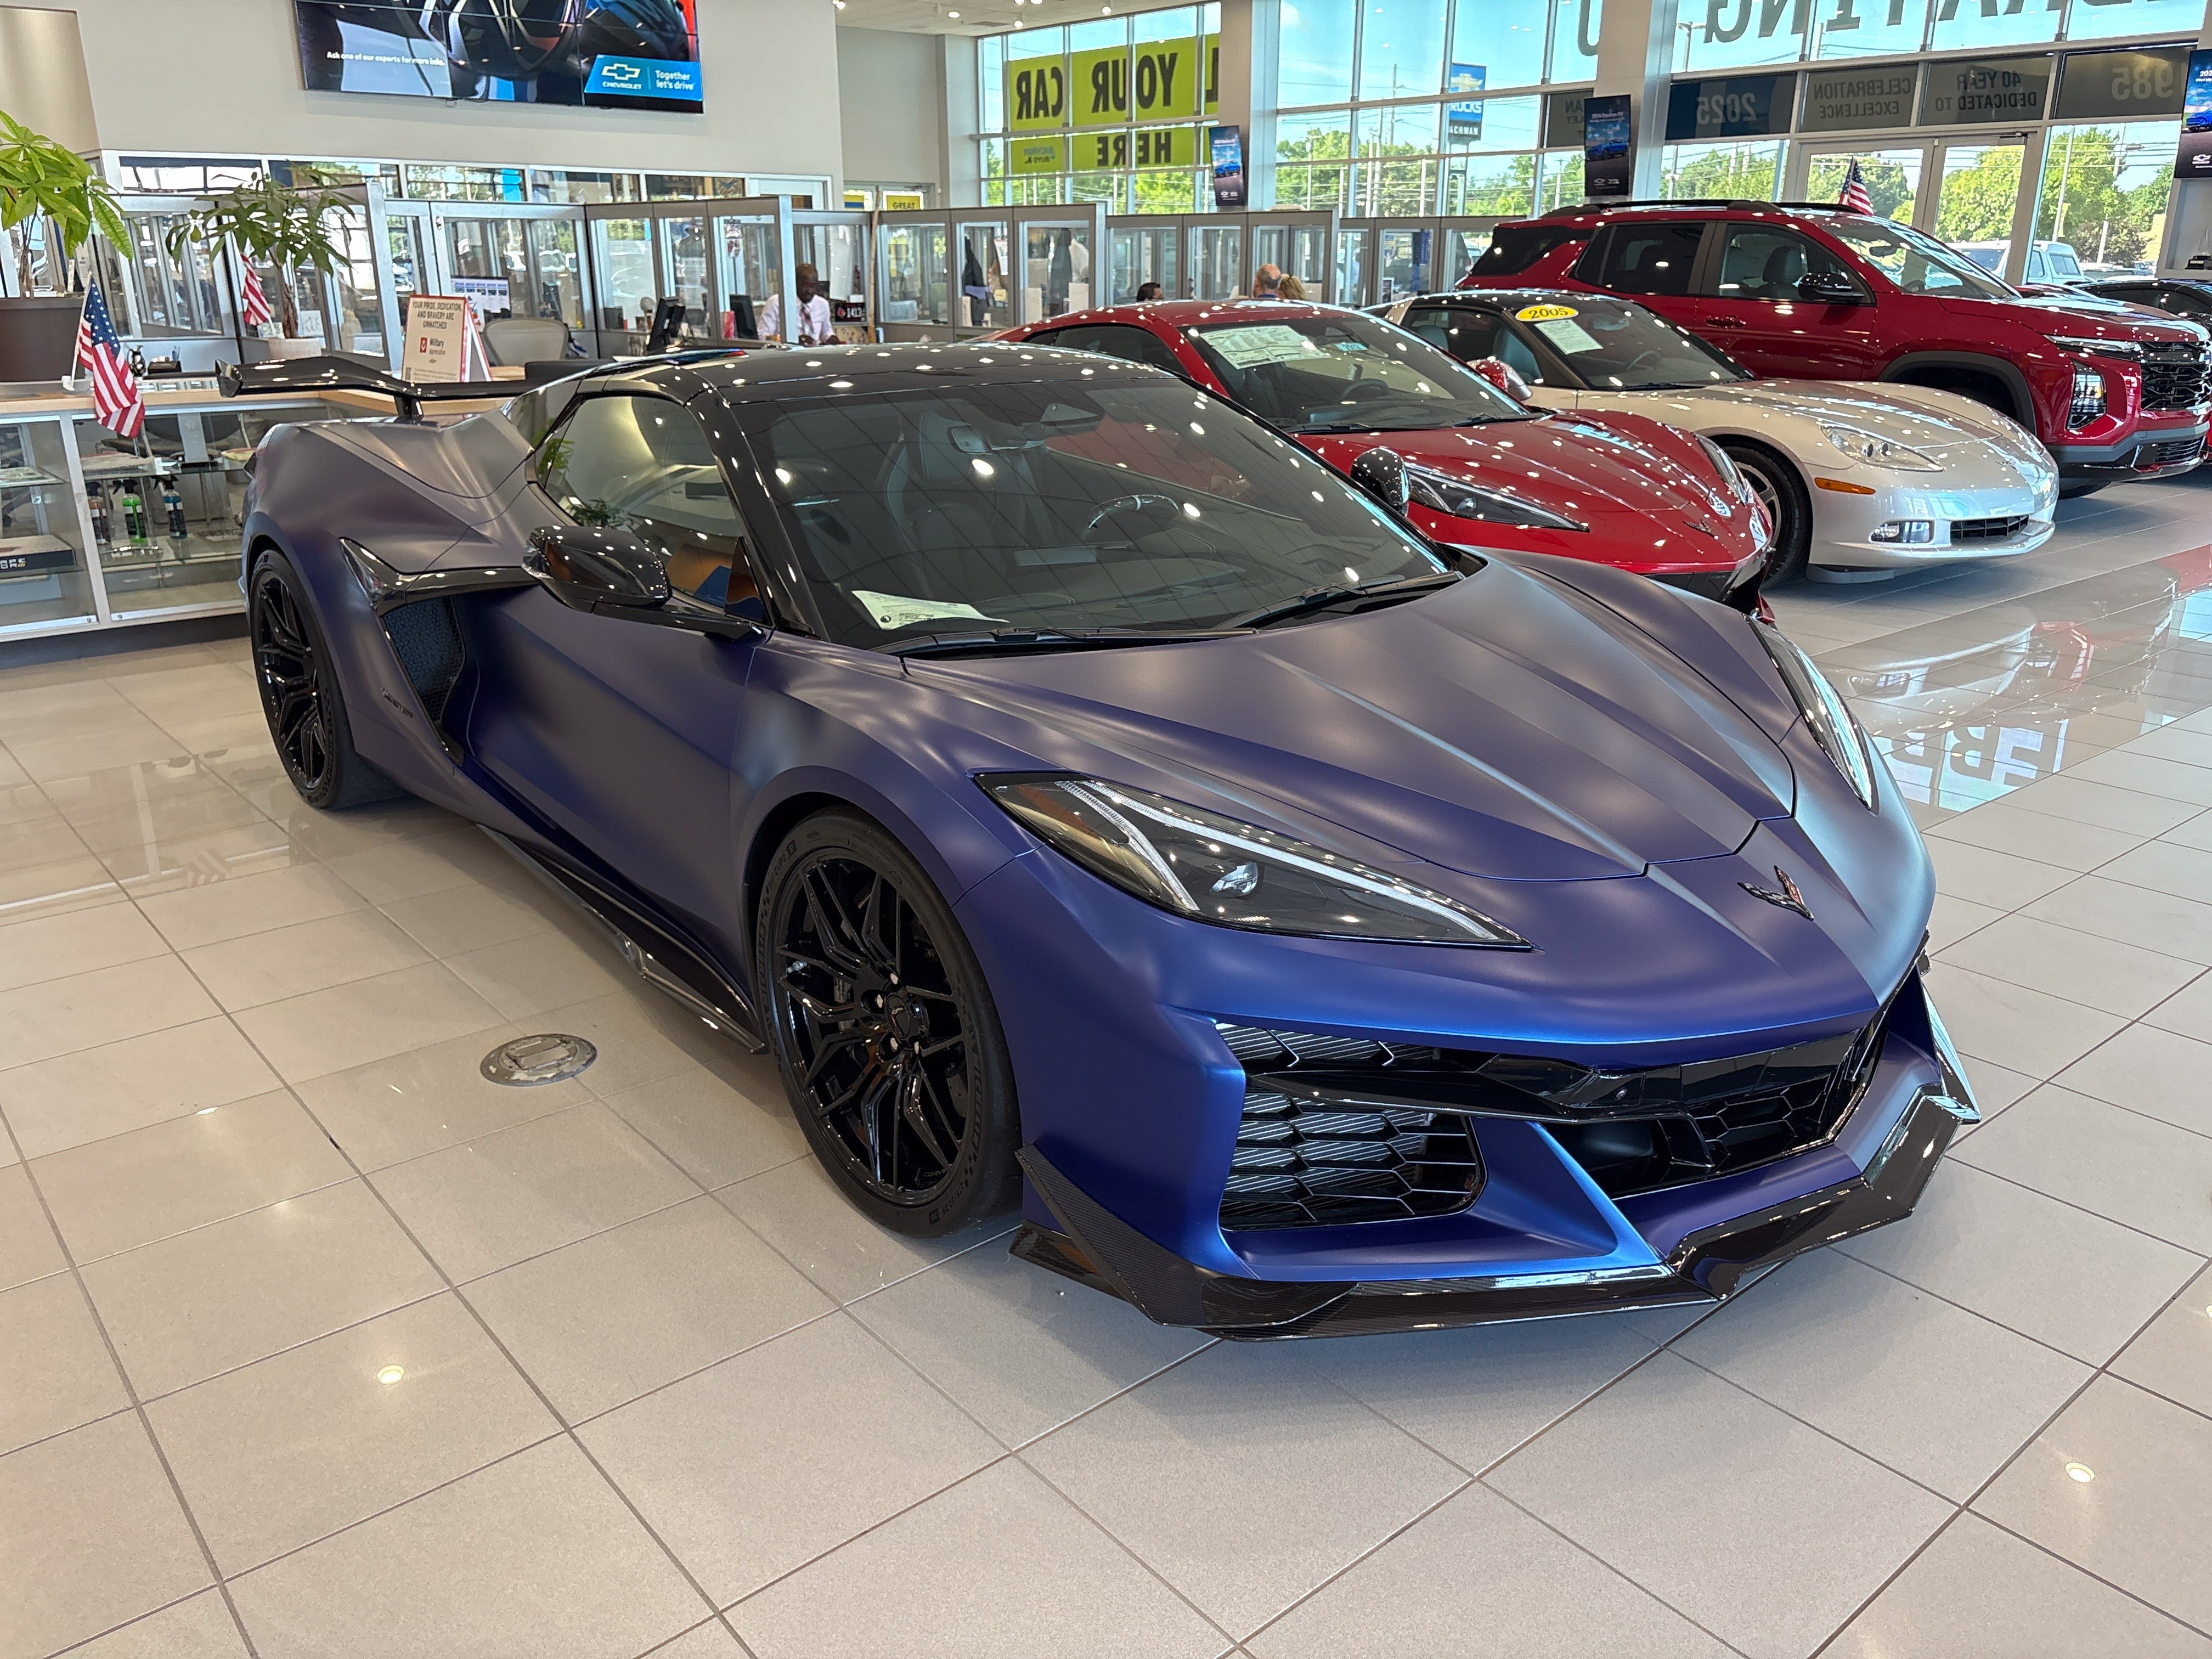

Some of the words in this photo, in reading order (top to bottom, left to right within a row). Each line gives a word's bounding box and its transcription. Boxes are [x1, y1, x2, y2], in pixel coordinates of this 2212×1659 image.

[655, 70, 691, 81] Together
[602, 81, 642, 90] CHEVROLET
[674, 81, 695, 91] drive
[1449, 101, 1482, 114] RUCKS
[1528, 308, 1568, 319] 2005
